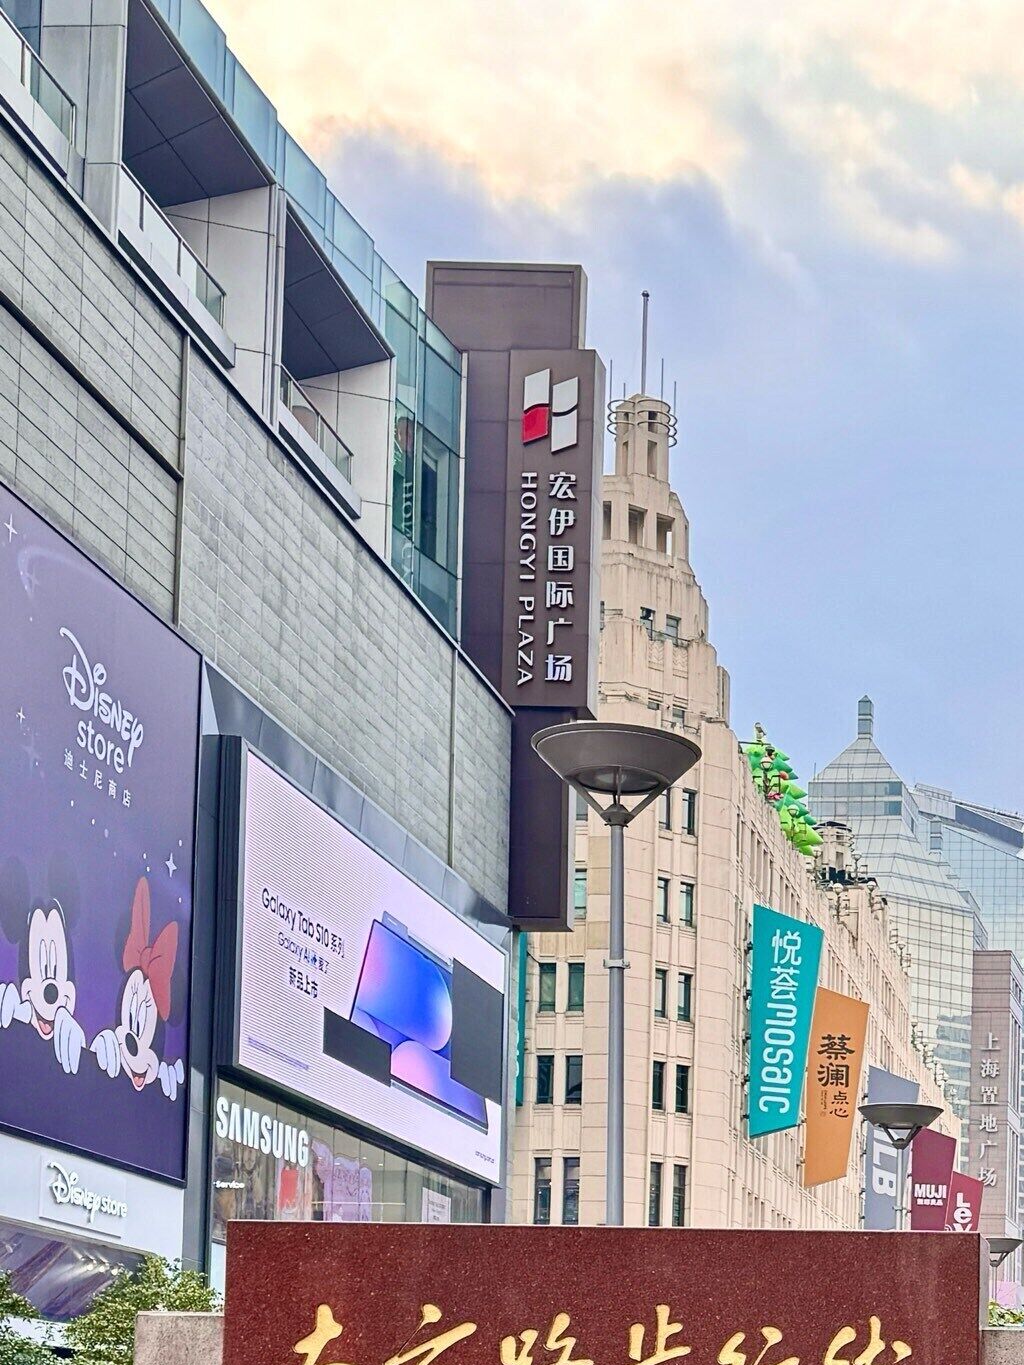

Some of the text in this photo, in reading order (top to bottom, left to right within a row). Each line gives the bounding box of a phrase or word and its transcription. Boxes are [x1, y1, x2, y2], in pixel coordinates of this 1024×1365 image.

[517, 472, 538, 686] HONGYI PLAZA
[545, 471, 577, 683] 宏伊国际广场
[59, 626, 144, 767] Disney
[77, 720, 125, 773] store
[63, 748, 132, 808] 迪士尼商店
[262, 888, 296, 931] Galaxy
[298, 910, 315, 938] Tab
[315, 923, 330, 948] S10
[277, 932, 303, 962] Galaxy
[289, 966, 318, 998] 新品上市
[758, 1002, 798, 1114] mosaic
[216, 1096, 309, 1168] SAMSUNG
[976, 1032, 1000, 1188] 上海置地广场
[48, 1161, 128, 1223] Disney store
[914, 1183, 947, 1198] MUJI
